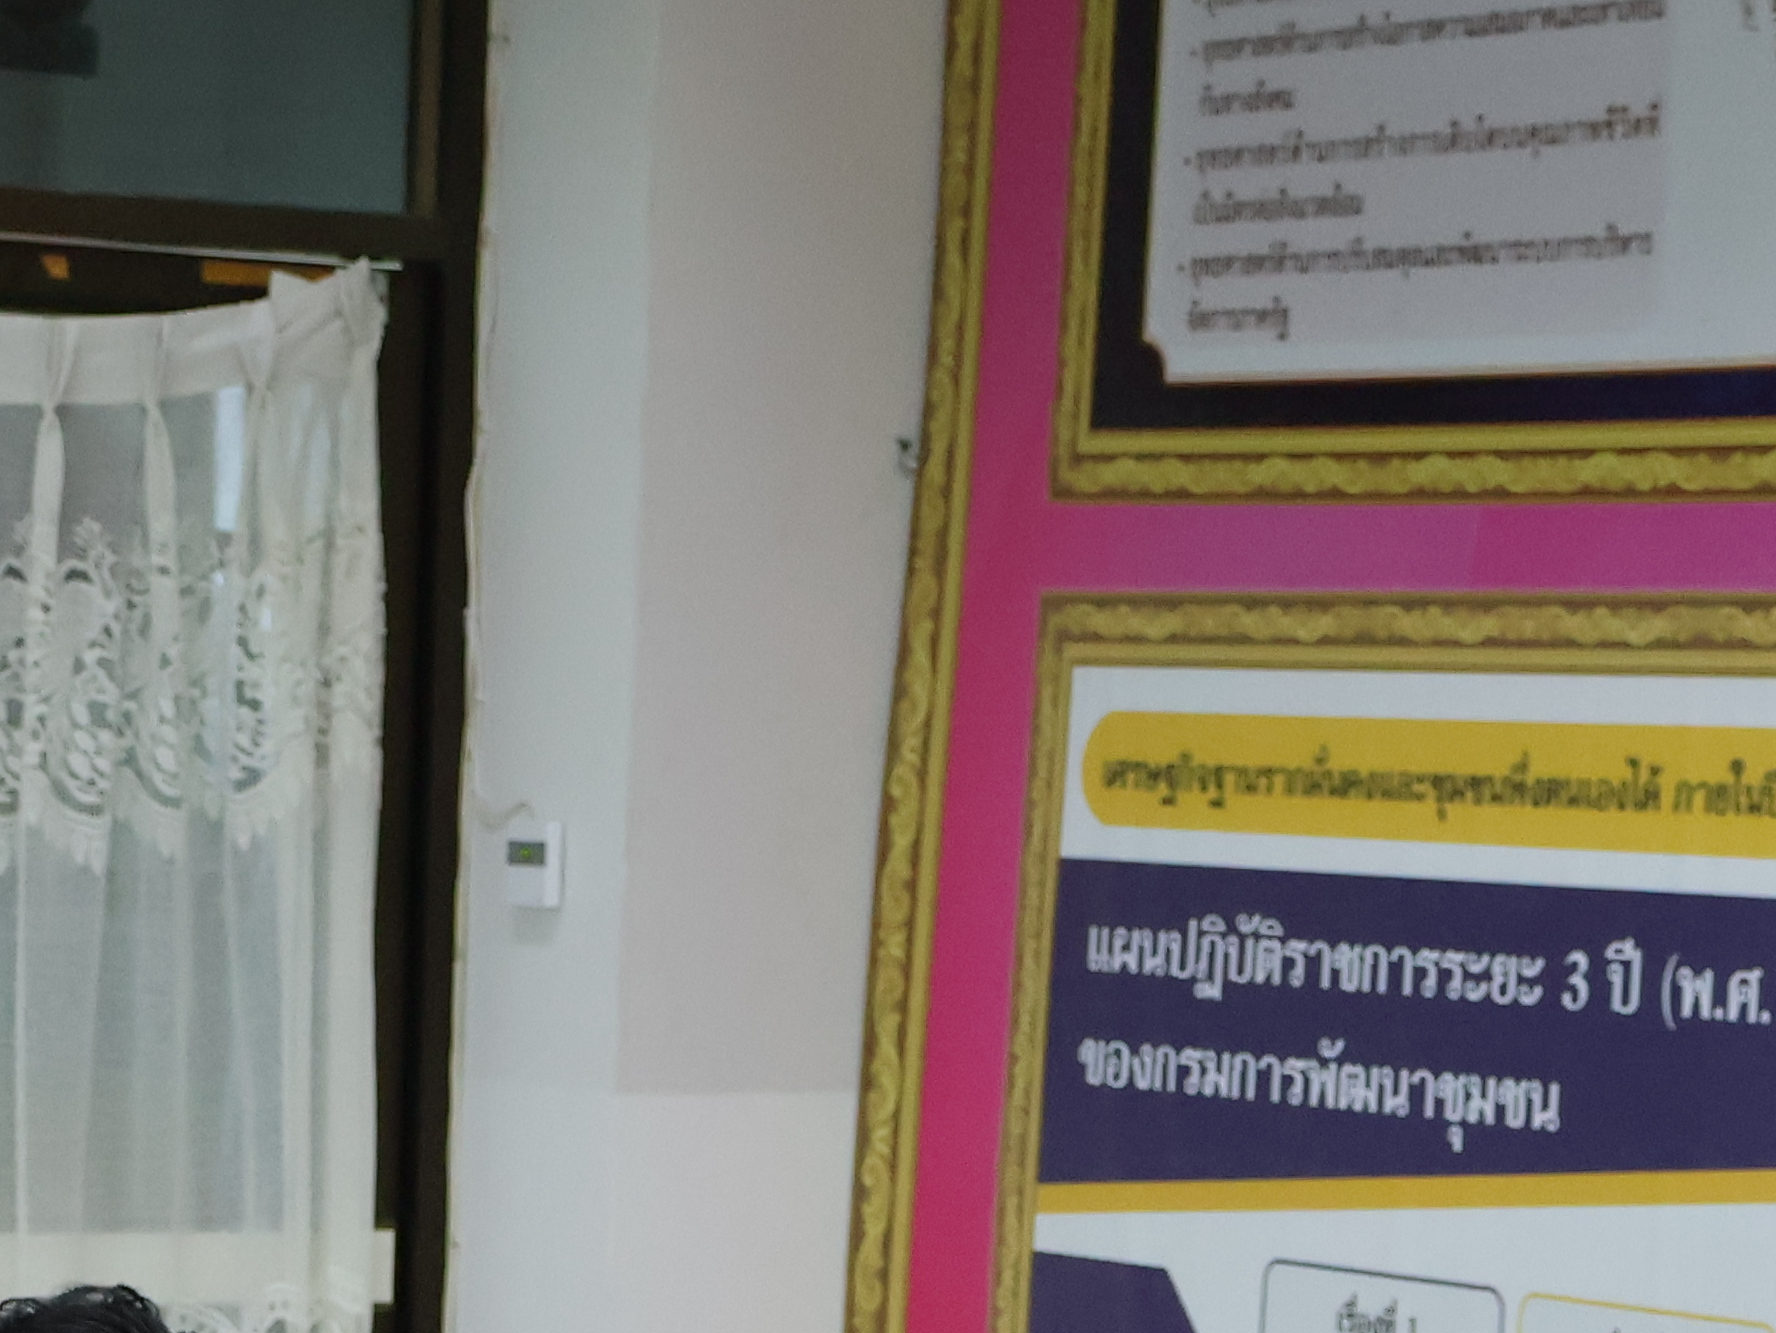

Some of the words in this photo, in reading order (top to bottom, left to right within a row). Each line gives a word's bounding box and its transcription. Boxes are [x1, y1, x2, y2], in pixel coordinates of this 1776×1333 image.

[1086, 913, 1545, 1001] แผนปฏิบัติราชการระยะ
[1561, 950, 1590, 1012] 3
[1608, 938, 1644, 1015] ปี
[1661, 953, 1771, 1029] (พ.ศ.
[1078, 1037, 1562, 1152] ของกรมการพัฒนาชุมชน
